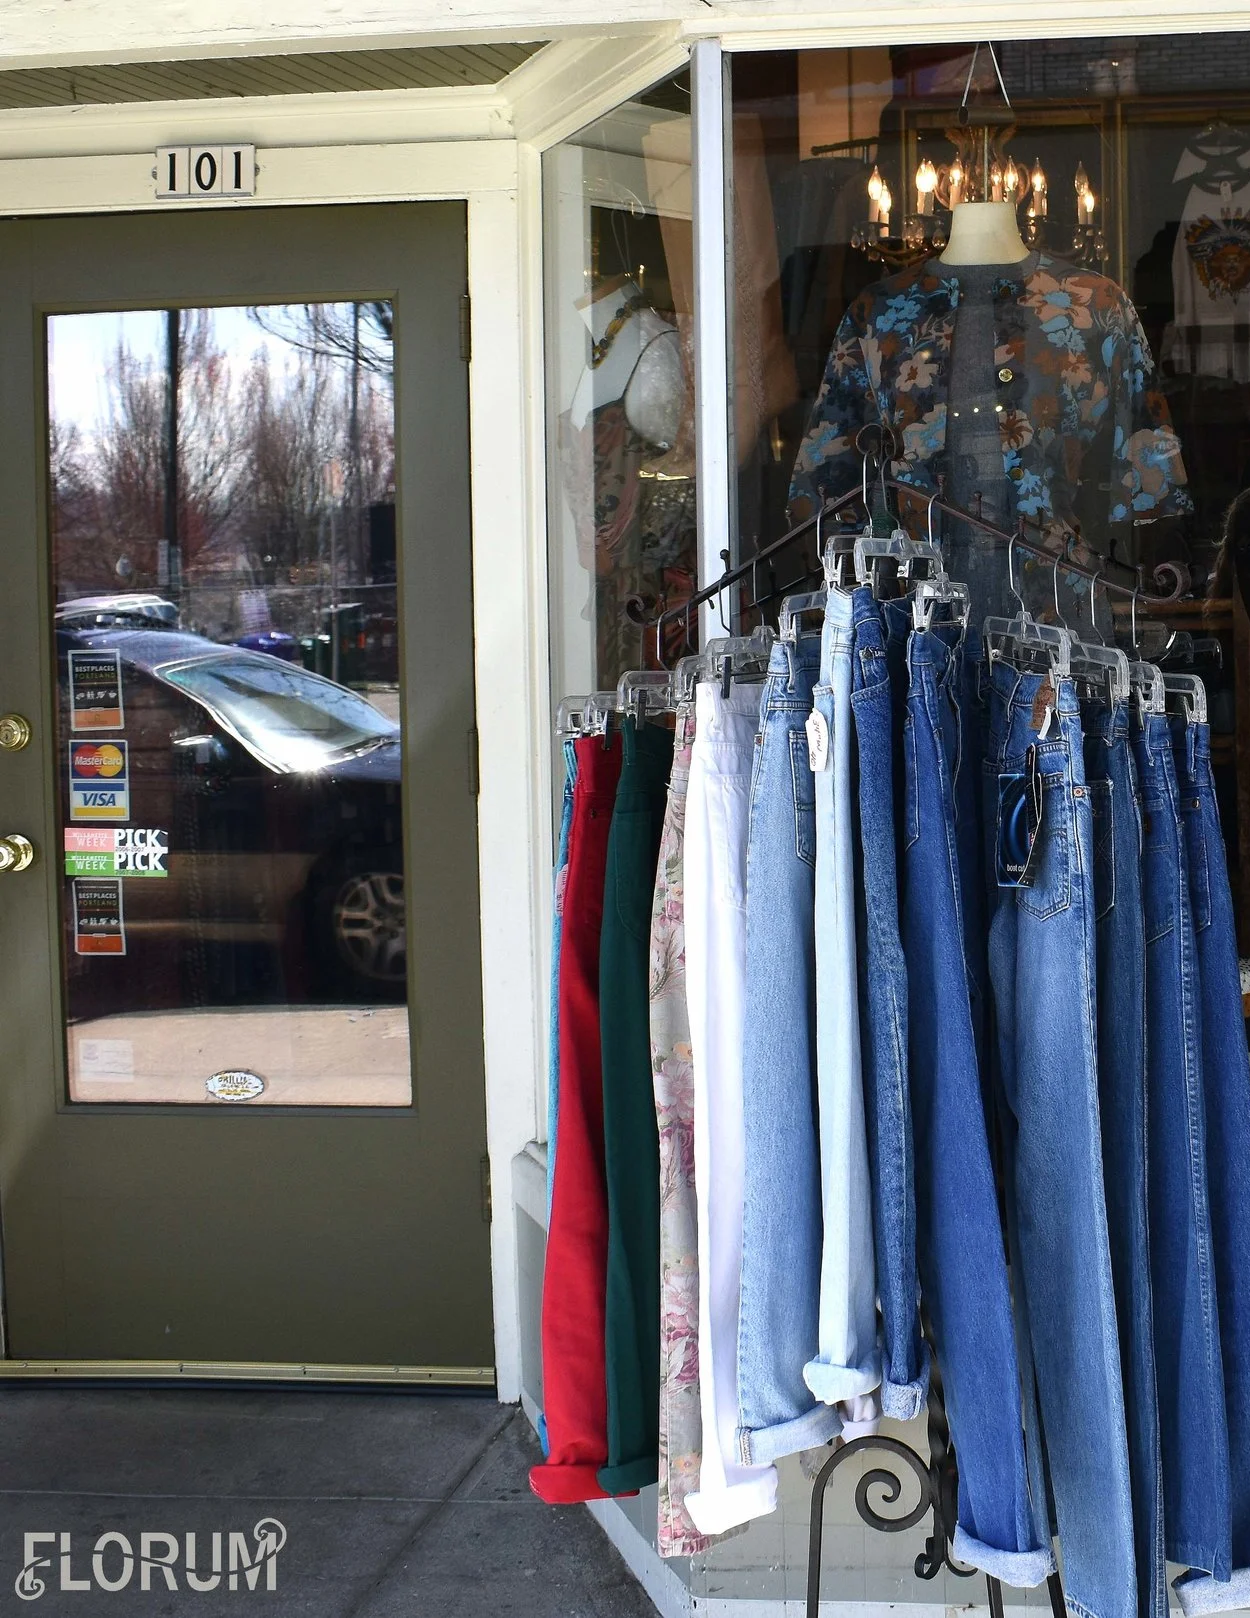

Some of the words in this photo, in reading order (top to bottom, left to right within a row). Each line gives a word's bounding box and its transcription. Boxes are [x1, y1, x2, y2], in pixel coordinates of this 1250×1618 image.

[167, 151, 241, 192] 101
[74, 756, 123, 766] MasterCard
[82, 793, 116, 806] VISA
[76, 837, 106, 847] WEEK
[114, 828, 162, 847] PICK
[75, 860, 106, 870] WEEK
[114, 852, 165, 870] PICK
